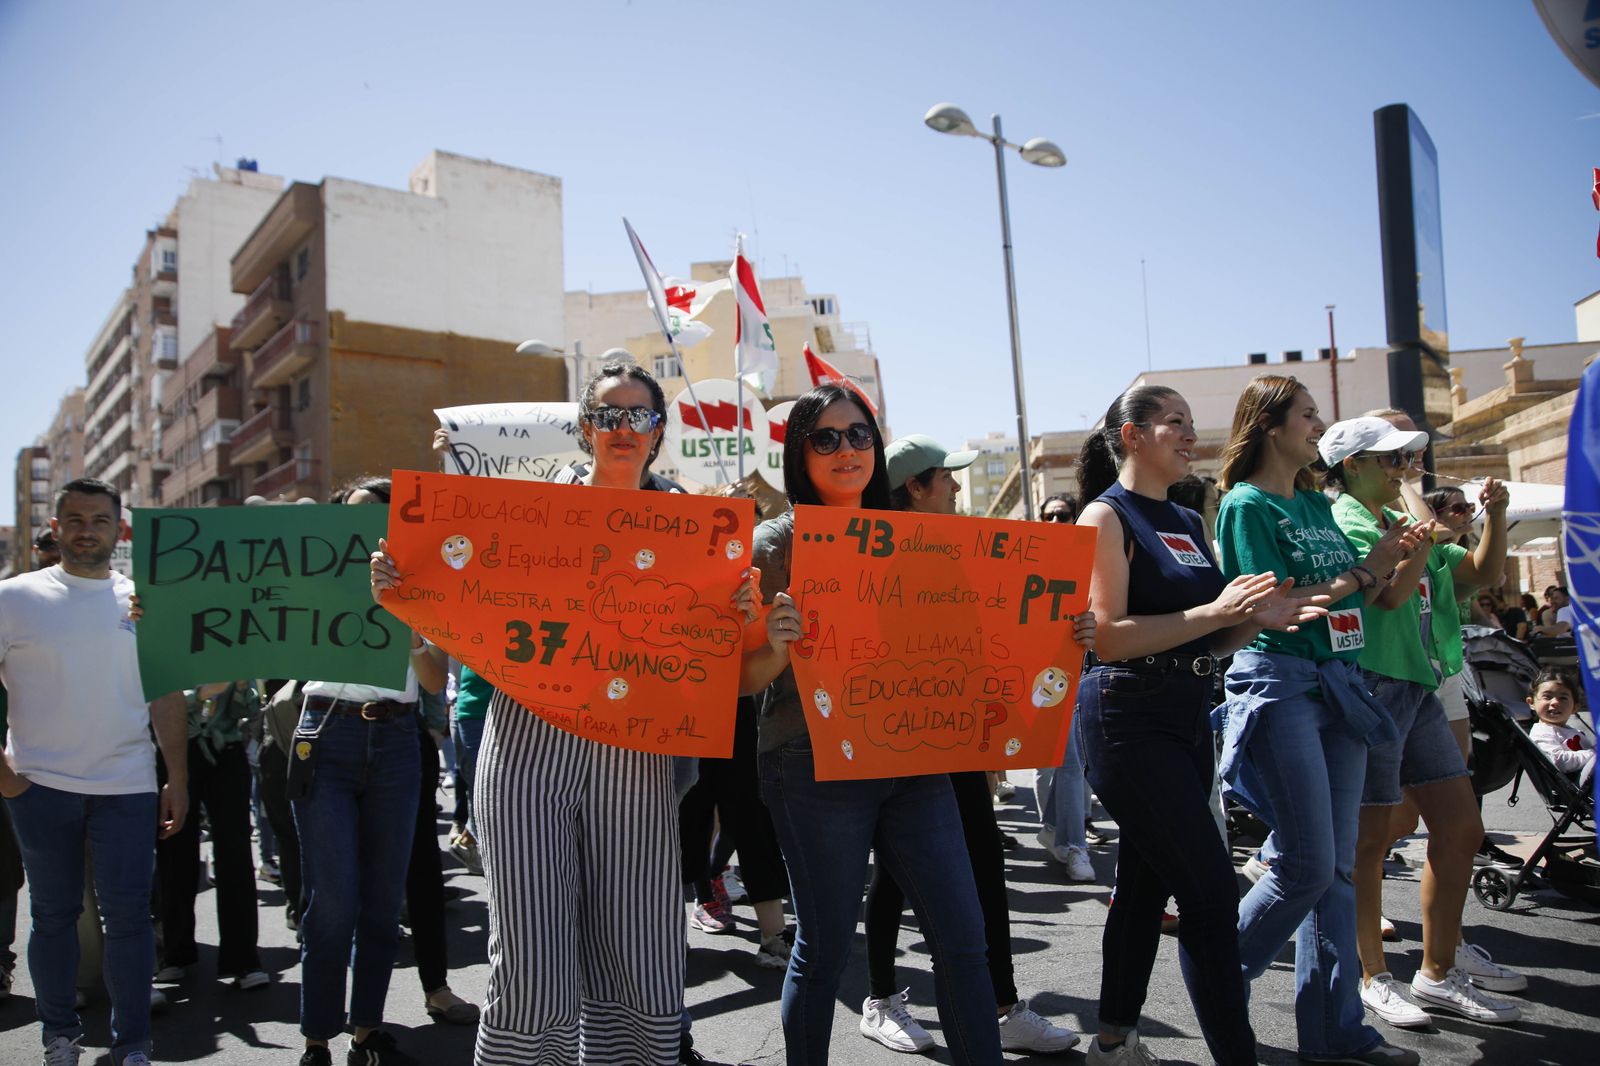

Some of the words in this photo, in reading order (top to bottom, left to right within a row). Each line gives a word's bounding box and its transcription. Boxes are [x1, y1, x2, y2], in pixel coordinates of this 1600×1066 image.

[498, 427, 508, 438] A
[681, 436, 756, 458] USTEA
[563, 509, 592, 529] DE
[148, 514, 372, 586] BAJADA
[844, 517, 895, 558] 43
[973, 528, 1047, 565] NEAE
[1175, 552, 1210, 565] USTEA
[251, 584, 290, 604] DE
[460, 578, 553, 612] MAESTRA
[566, 597, 587, 613] DE
[857, 568, 903, 608] UNA
[916, 583, 982, 609] maestra
[984, 581, 1008, 610] de
[190, 604, 393, 655] RATIOS
[659, 622, 737, 645] LENGUAJE
[1336, 633, 1364, 649] USTEA
[504, 619, 571, 667] 37
[570, 631, 708, 683] ALUMN@S
[850, 636, 892, 660] ESO
[983, 676, 1018, 698] DE
[583, 713, 620, 738] PARA
[627, 717, 655, 738] PT
[674, 713, 708, 739] AL
